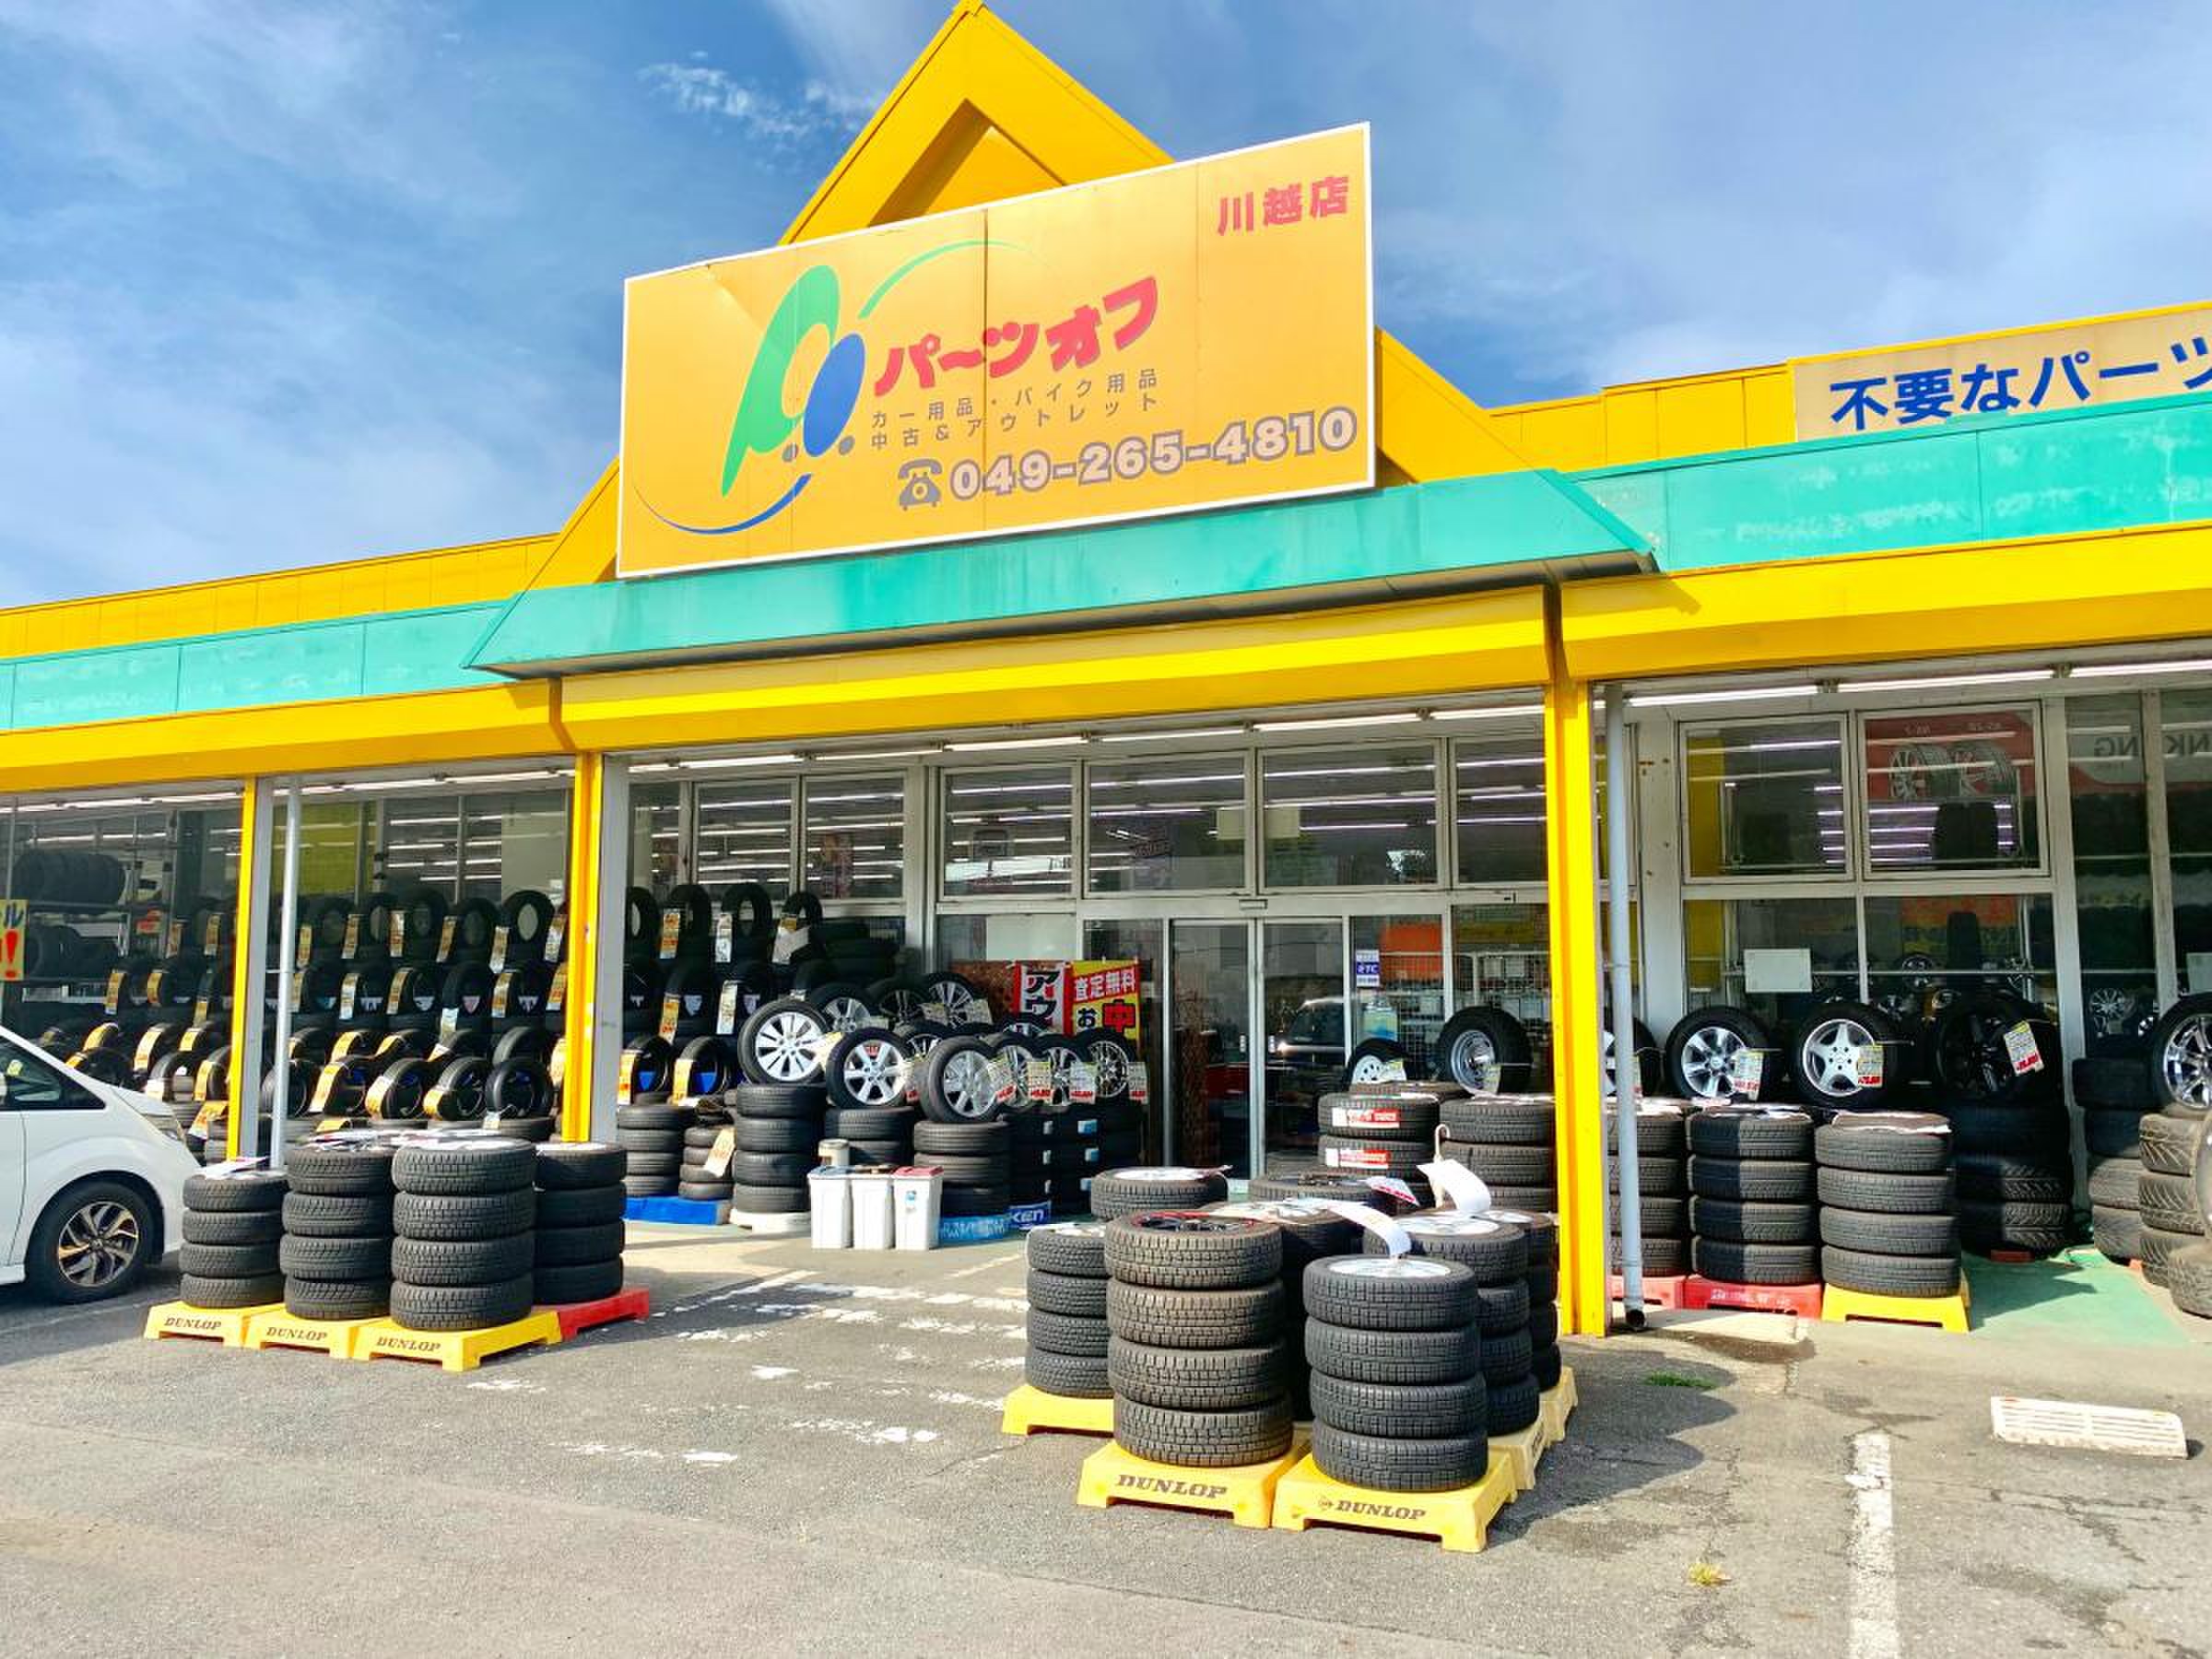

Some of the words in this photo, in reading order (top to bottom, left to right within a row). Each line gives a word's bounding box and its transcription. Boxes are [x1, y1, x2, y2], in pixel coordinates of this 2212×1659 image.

[1216, 175, 1350, 236] 川越店
[873, 276, 1159, 397] パーツオフ
[1830, 336, 2212, 431] 不要なパーツ
[948, 406, 1358, 500] 049-265-4810
[165, 1316, 222, 1331] DUNLOP
[265, 1325, 328, 1342] DUNLOP
[376, 1335, 441, 1354] DUNLOP
[1115, 1474, 1228, 1500] DUNLOP
[1335, 1500, 1427, 1520] DUNLOP
